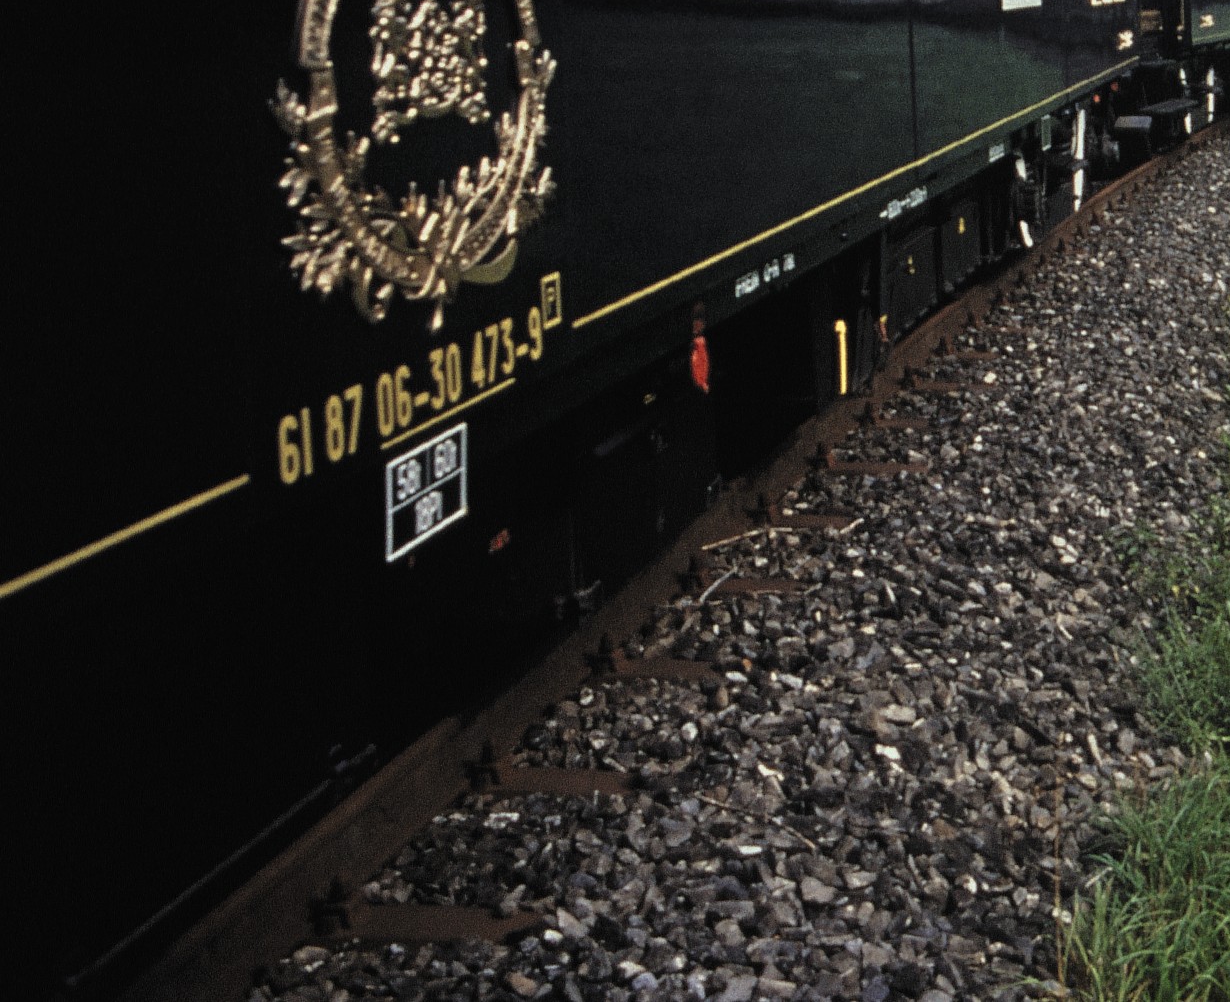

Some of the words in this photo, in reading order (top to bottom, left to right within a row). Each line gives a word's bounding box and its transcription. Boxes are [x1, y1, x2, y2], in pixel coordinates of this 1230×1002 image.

[278, 406, 314, 485] 61
[324, 382, 364, 464] 87
[376, 342, 463, 438] 06-30
[471, 306, 544, 390] 473-9
